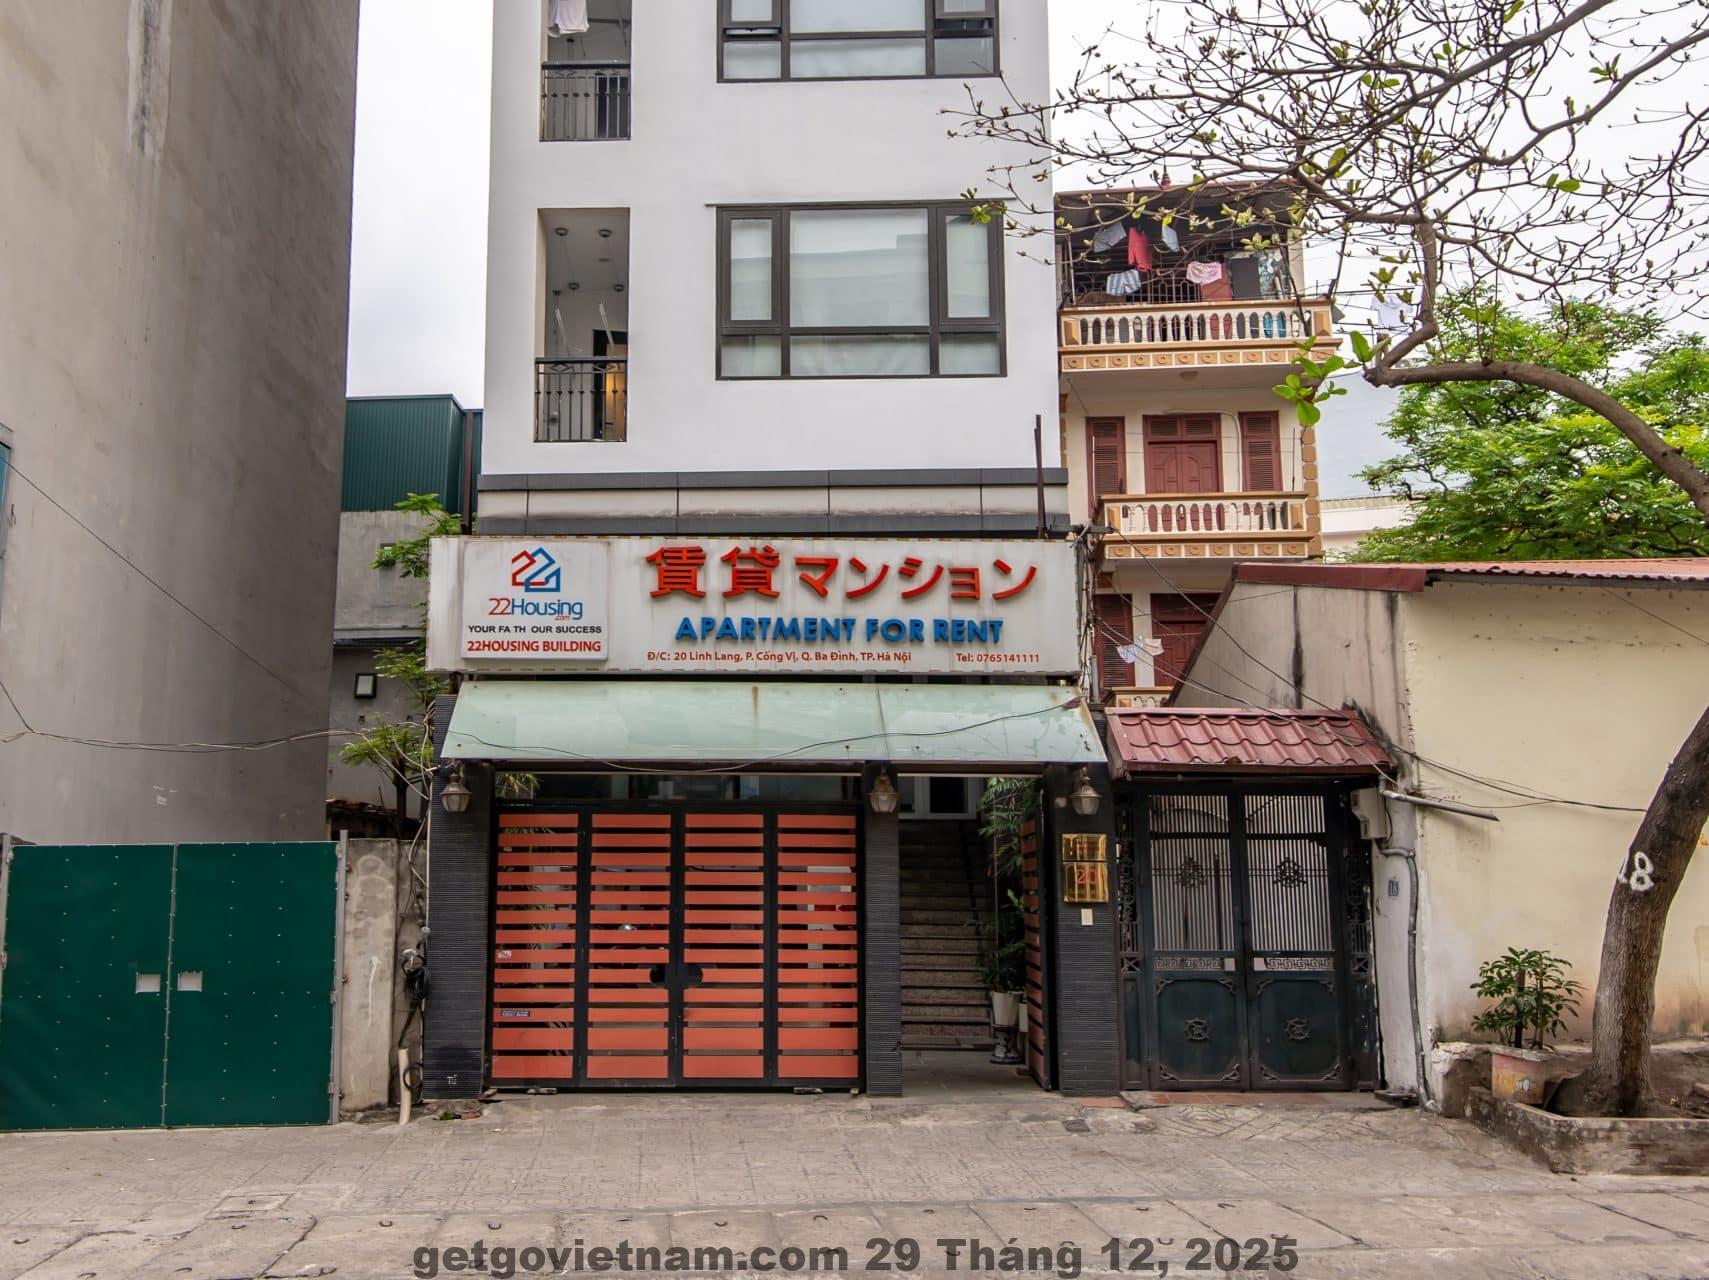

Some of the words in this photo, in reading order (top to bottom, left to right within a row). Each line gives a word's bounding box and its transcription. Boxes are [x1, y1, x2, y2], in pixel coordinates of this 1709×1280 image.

[646, 545, 1037, 601] 賃貸マンション
[488, 597, 583, 620] 22Housing
[468, 625, 496, 634] YOUR
[531, 625, 553, 634] OUR
[555, 625, 602, 634] SUCCESS
[675, 616, 857, 643] APARTMENT
[865, 618, 925, 643] FOR
[933, 619, 1004, 644] RENT
[467, 640, 539, 652] 22HOUSING
[542, 640, 601, 652] BUILDING
[647, 651, 671, 661] Đ/C:
[674, 652, 687, 661] 20
[689, 651, 712, 661] Linh
[714, 651, 743, 663] Lang,
[745, 651, 754, 661] P.
[756, 650, 784, 663] Cống
[801, 651, 812, 662] Q.
[815, 652, 828, 661] Ba
[830, 651, 858, 663] Đình,
[860, 652, 875, 662] TP.
[877, 652, 891, 662] Hà
[894, 652, 911, 664] Nội
[956, 653, 974, 663] Tel:
[976, 653, 1040, 663] 0765141111
[1076, 868, 1097, 885] 20
